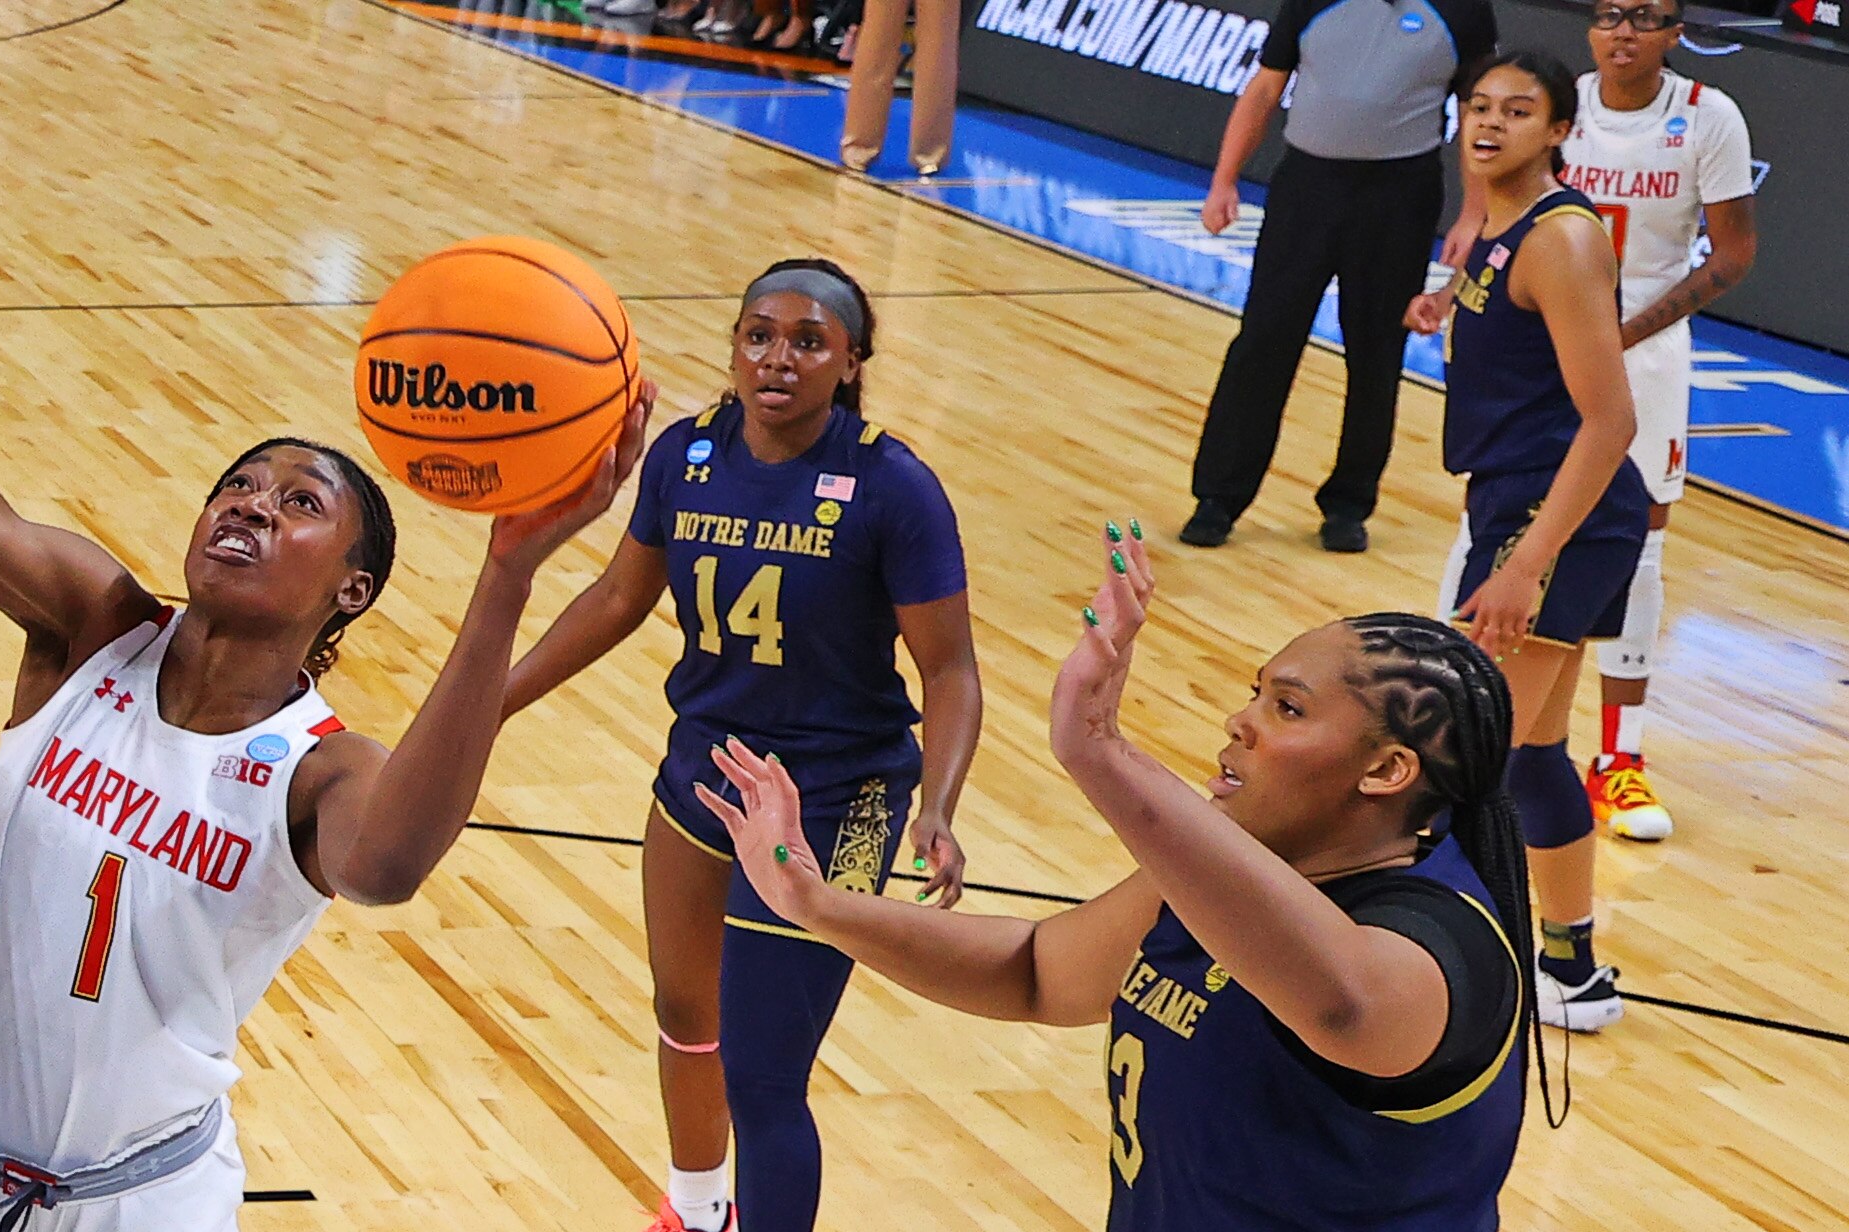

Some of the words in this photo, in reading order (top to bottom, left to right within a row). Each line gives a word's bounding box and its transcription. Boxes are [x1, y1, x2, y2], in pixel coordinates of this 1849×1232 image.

[369, 358, 537, 413] Wilson
[673, 511, 748, 547] NOTRE
[753, 521, 834, 558] DAME
[693, 555, 783, 667] 14
[28, 736, 252, 893] MARYLAND
[70, 850, 128, 1003] 1
